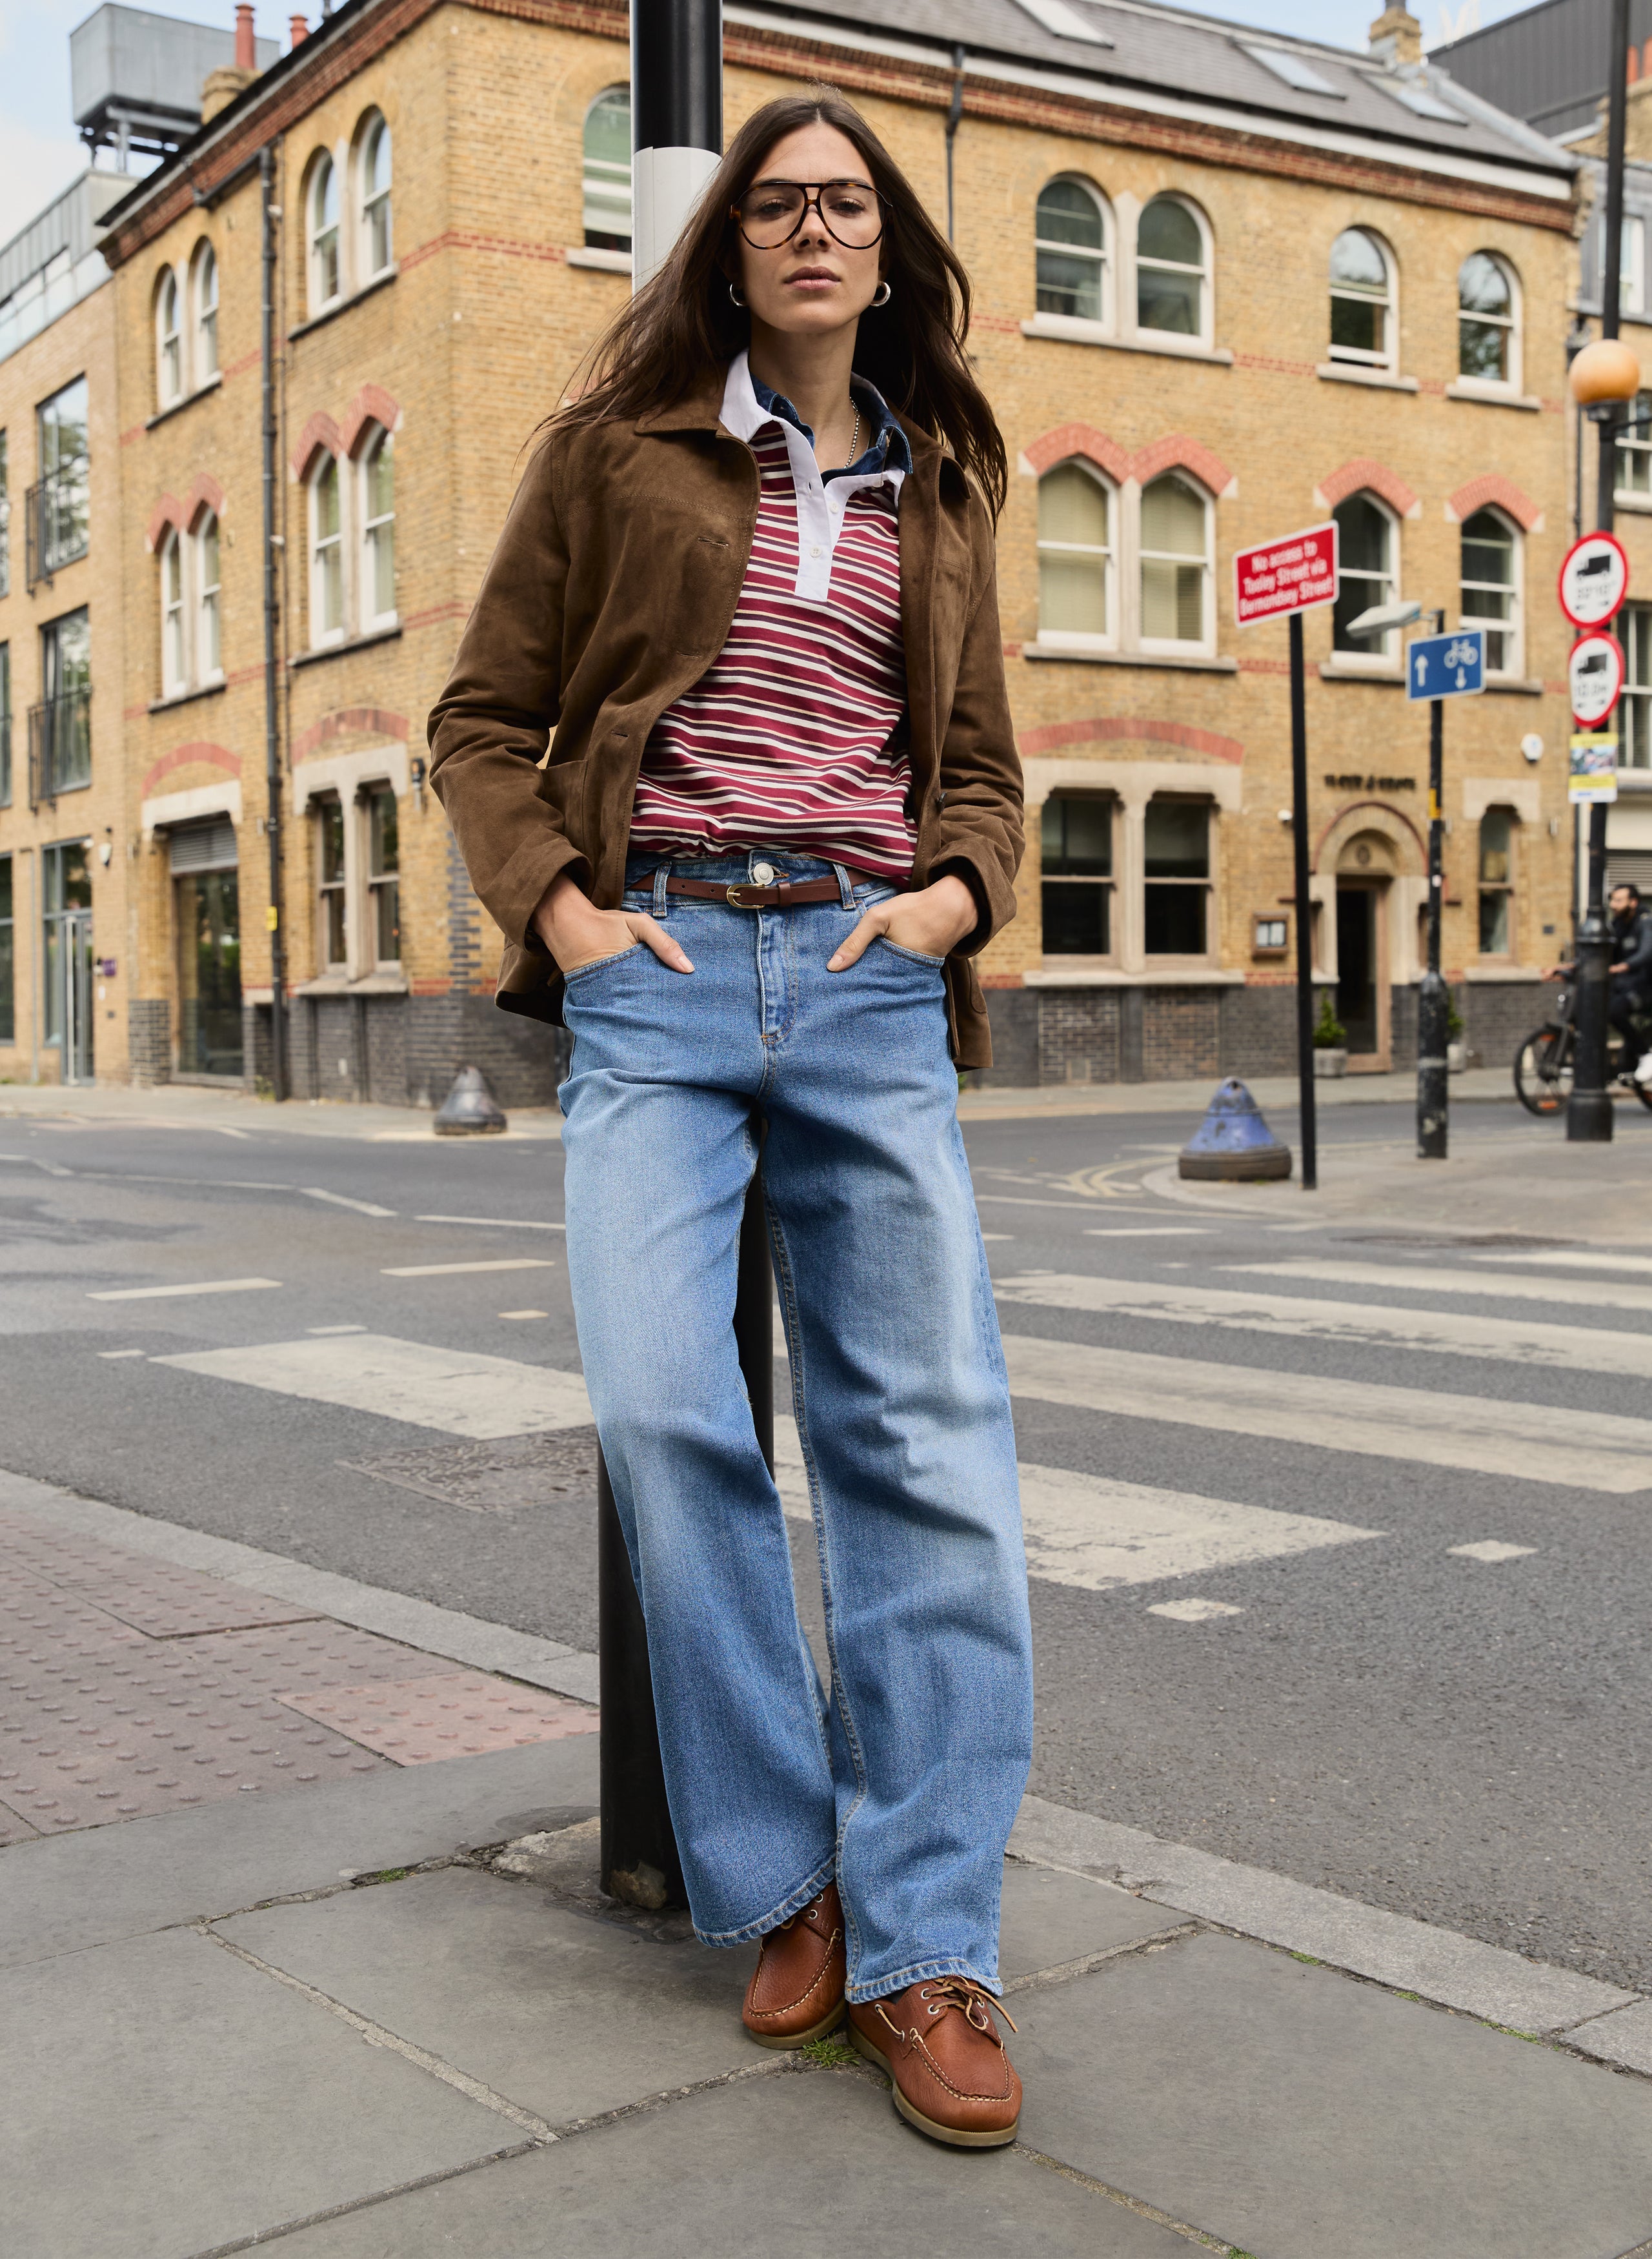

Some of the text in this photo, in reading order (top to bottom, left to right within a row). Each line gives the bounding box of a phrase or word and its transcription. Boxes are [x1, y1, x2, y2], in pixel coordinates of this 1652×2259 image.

[1252, 540, 1318, 573] No access to
[1276, 560, 1310, 586] Street
[1310, 556, 1327, 576] via
[1300, 574, 1333, 600] Street
